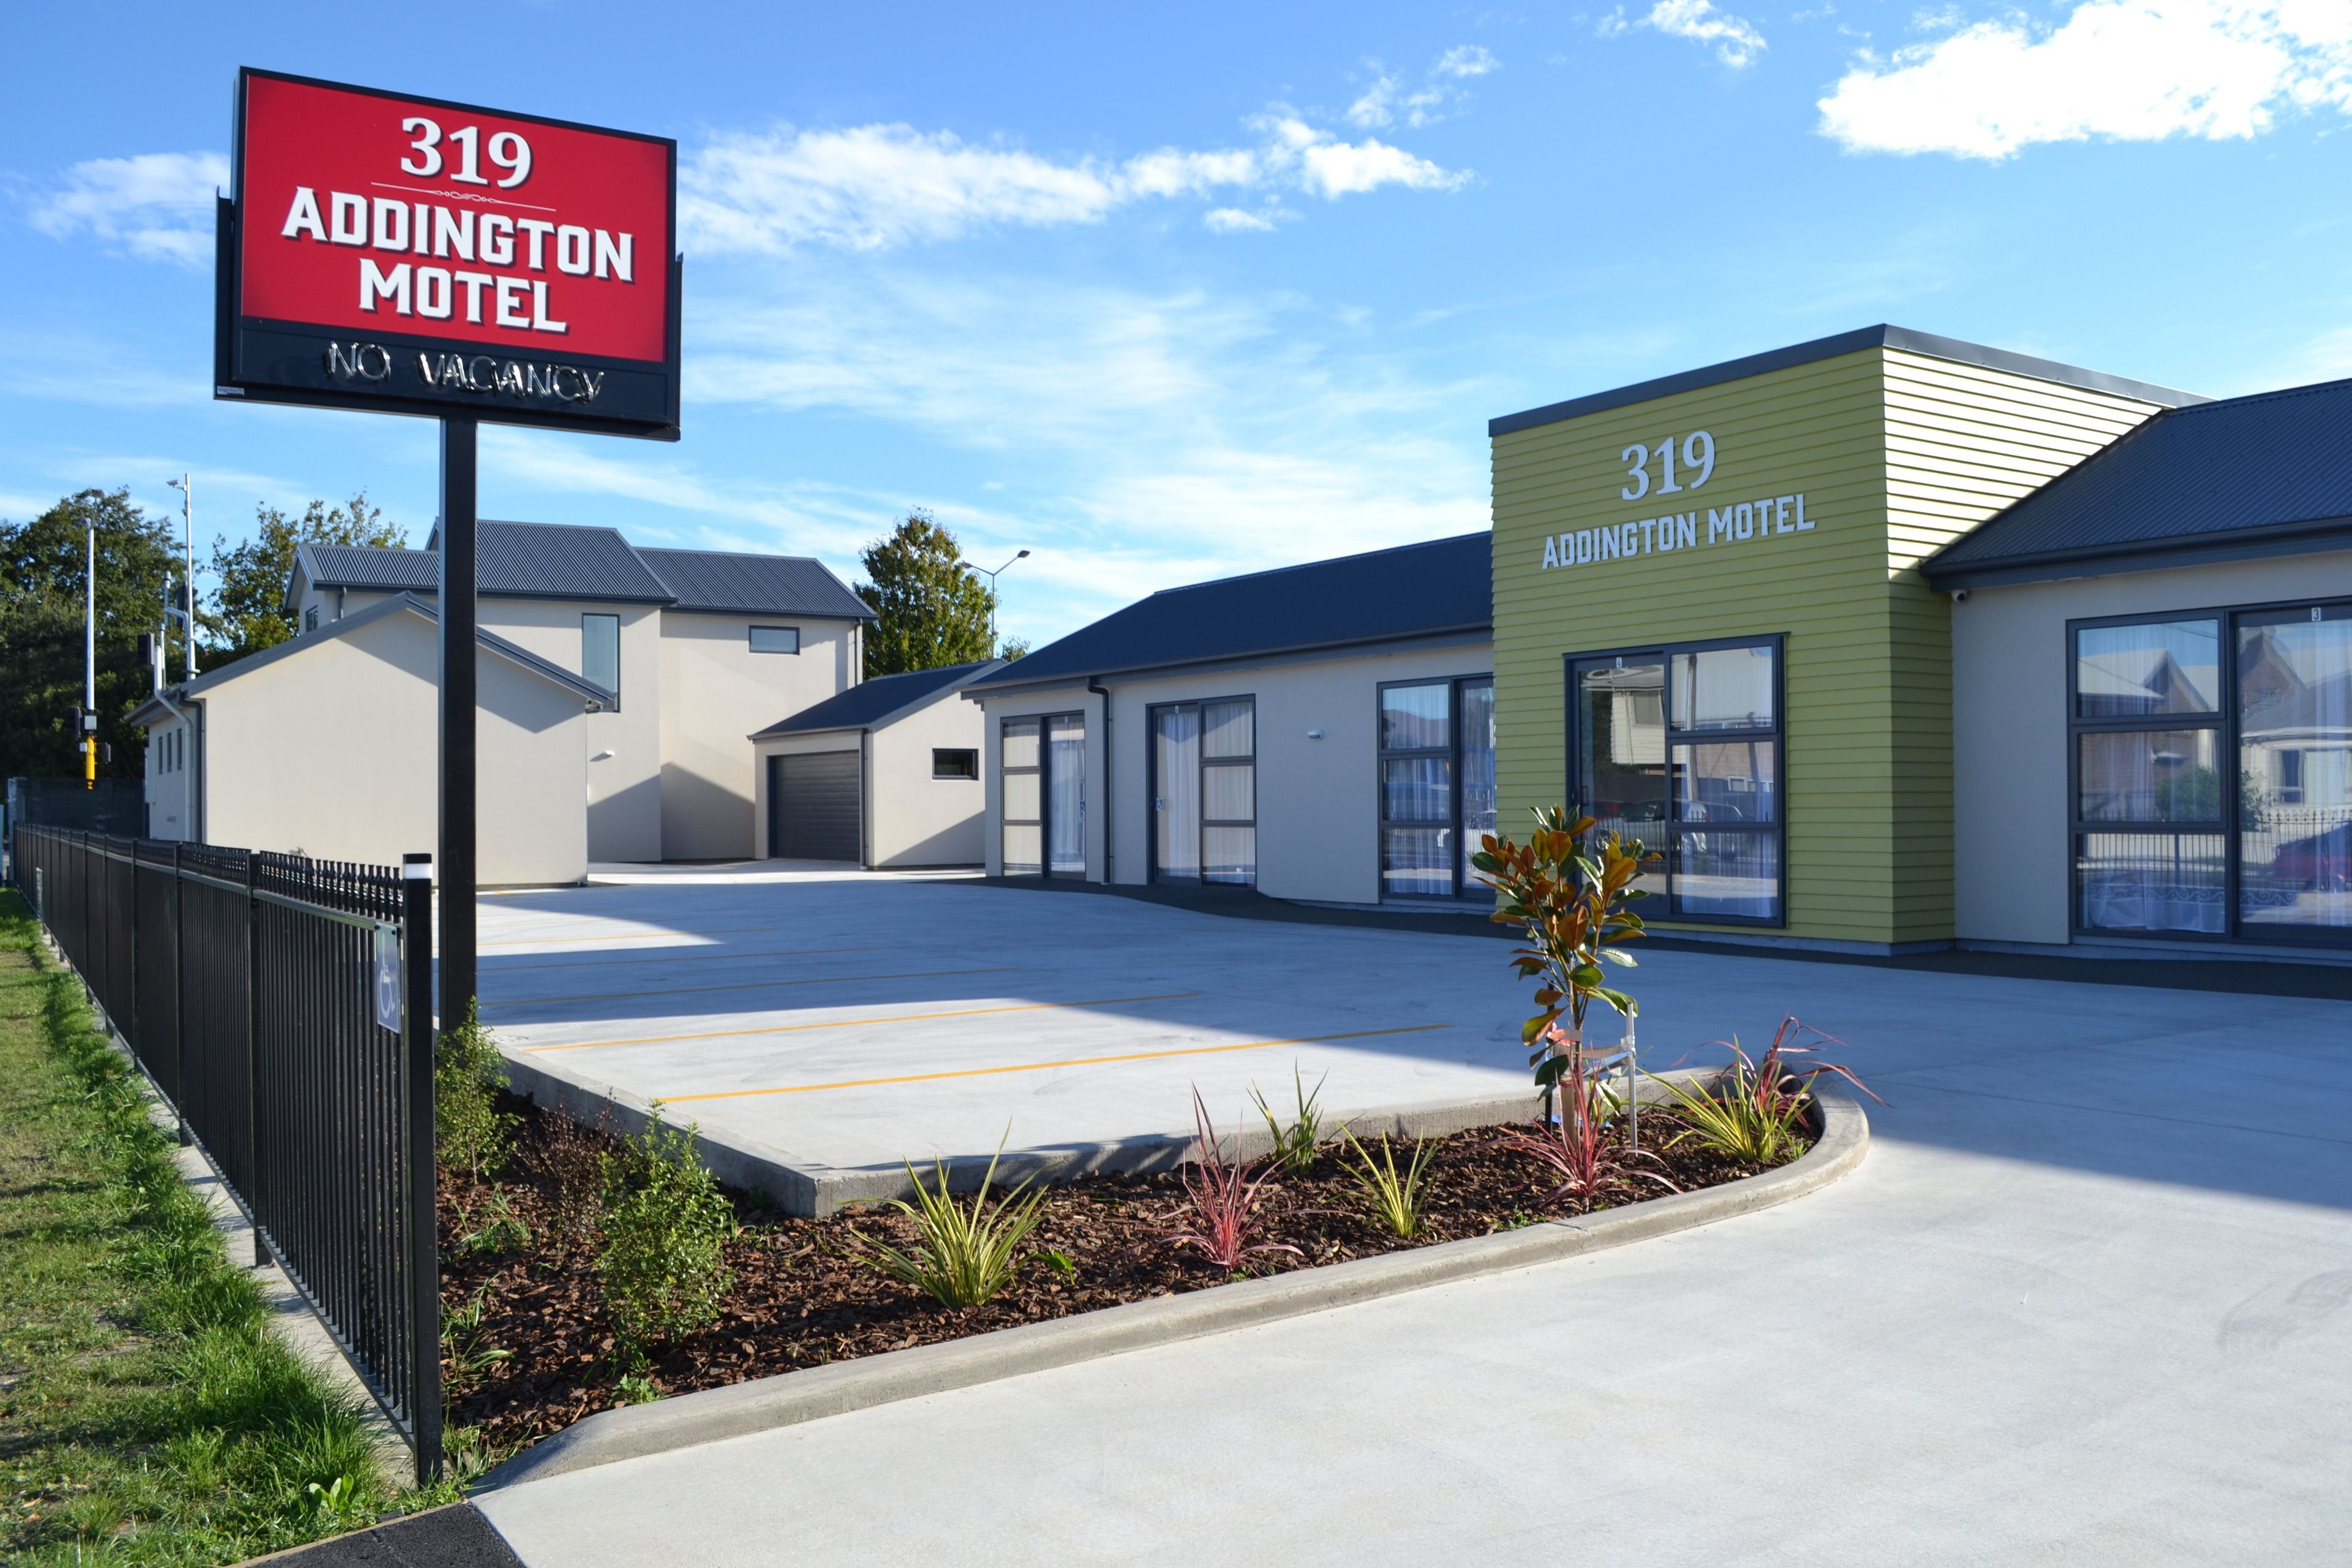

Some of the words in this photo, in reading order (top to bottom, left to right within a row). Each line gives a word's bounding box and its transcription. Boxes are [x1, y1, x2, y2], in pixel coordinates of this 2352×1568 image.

[401, 117, 531, 188] 319
[281, 186, 633, 282] ADDINGTON
[359, 258, 567, 333] MOTEL
[325, 341, 391, 381] NO
[418, 351, 605, 404] VACANCY
[1621, 430, 1716, 501] 319
[1540, 511, 1697, 570] ADDINGTON
[1707, 493, 1816, 545] MOTEL
